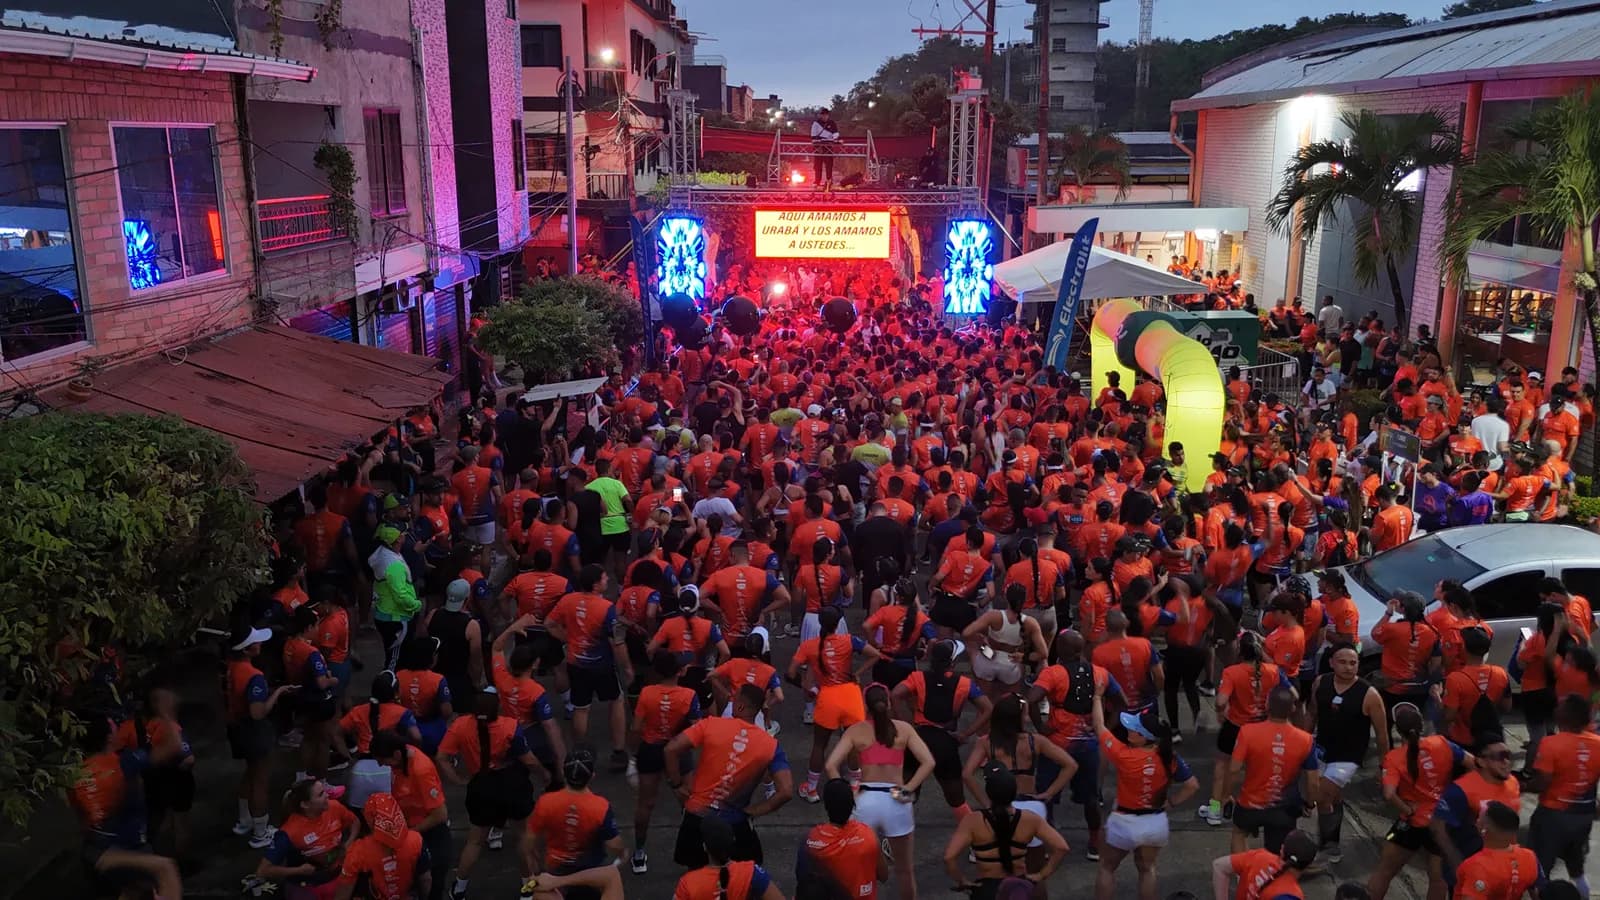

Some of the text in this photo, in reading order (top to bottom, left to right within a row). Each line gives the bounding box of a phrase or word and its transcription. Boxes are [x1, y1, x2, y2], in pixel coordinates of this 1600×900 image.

[807, 212, 857, 221] AMAMOS
[859, 212, 867, 221] A
[762, 224, 883, 236] URABÁ Y LOS AMAMOS
[788, 240, 796, 249] A
[1059, 235, 1090, 325] Electrolit
